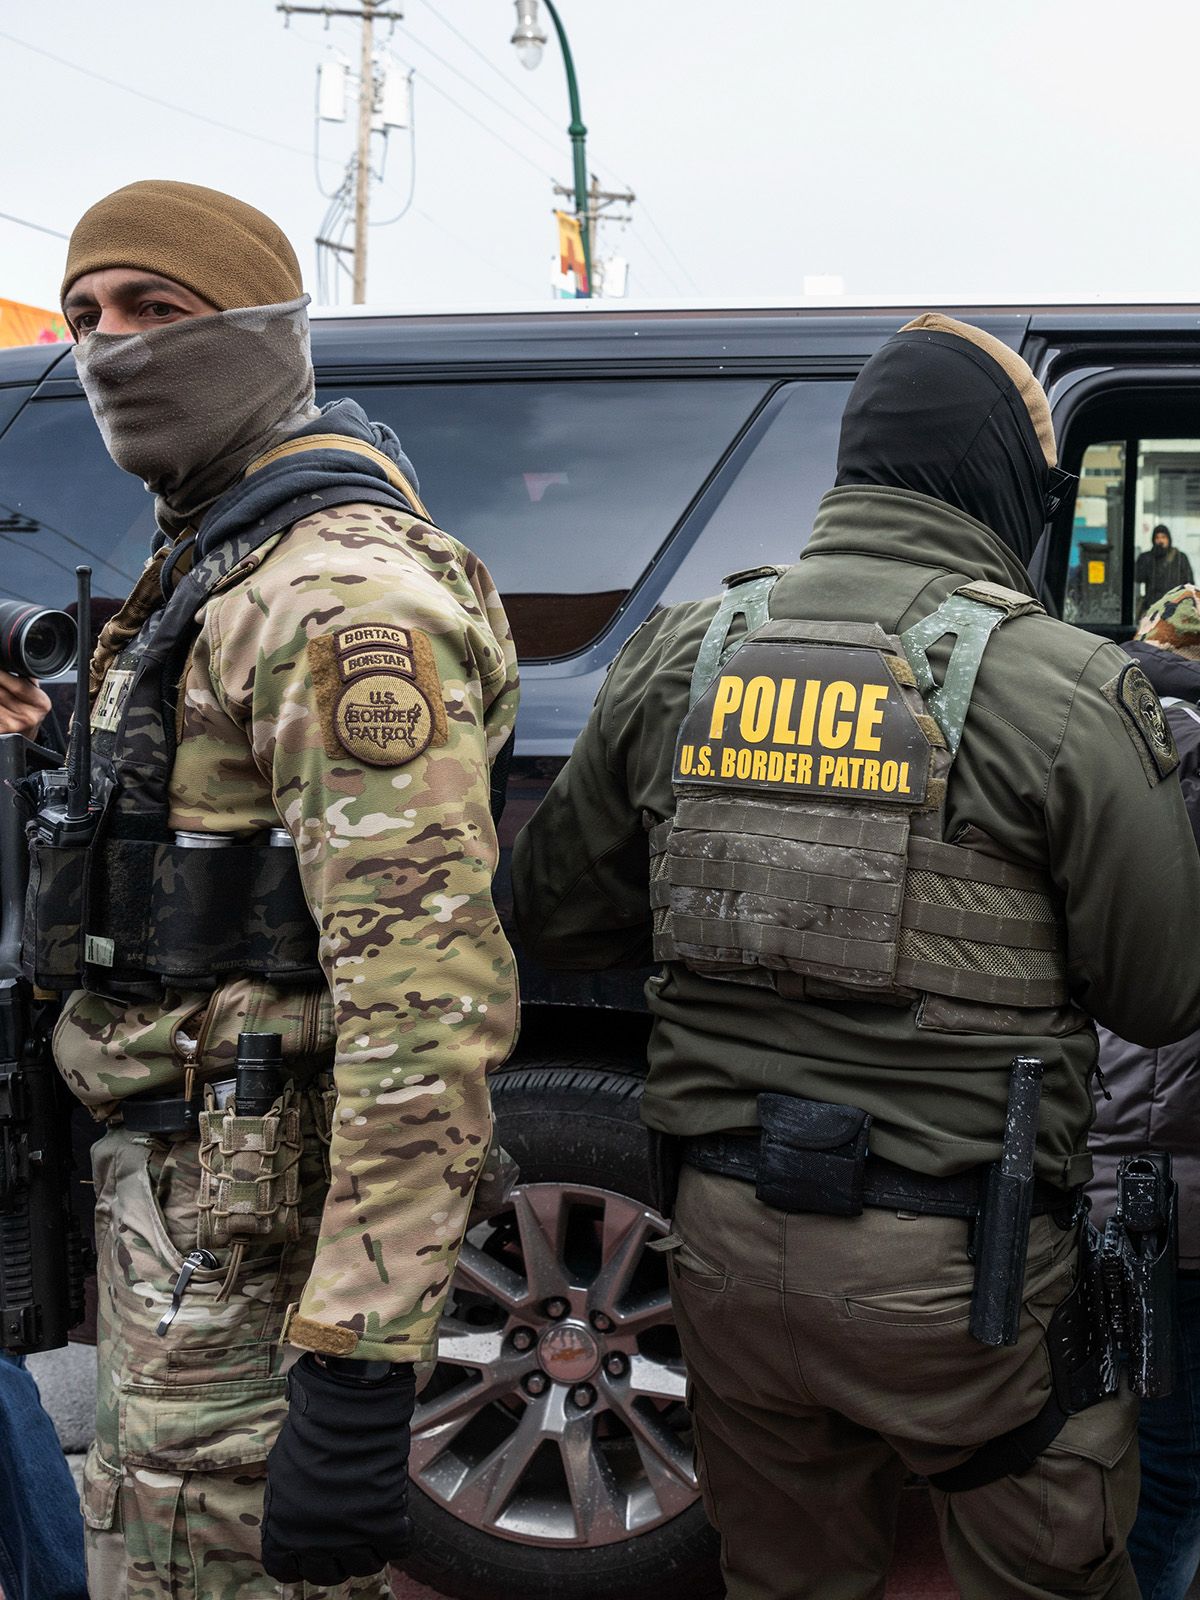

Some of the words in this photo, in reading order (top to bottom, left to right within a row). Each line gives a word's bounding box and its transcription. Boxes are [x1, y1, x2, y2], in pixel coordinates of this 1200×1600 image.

[345, 629, 400, 646] BORTAC
[349, 655, 407, 671] BORSTAR
[369, 691, 399, 705] U.S.
[349, 710, 419, 724] BORDER
[710, 675, 889, 752] POLICE
[350, 727, 418, 741] PATROL
[680, 744, 715, 778] U.S.
[720, 746, 812, 785] BORDER
[817, 754, 911, 795] PATROL
